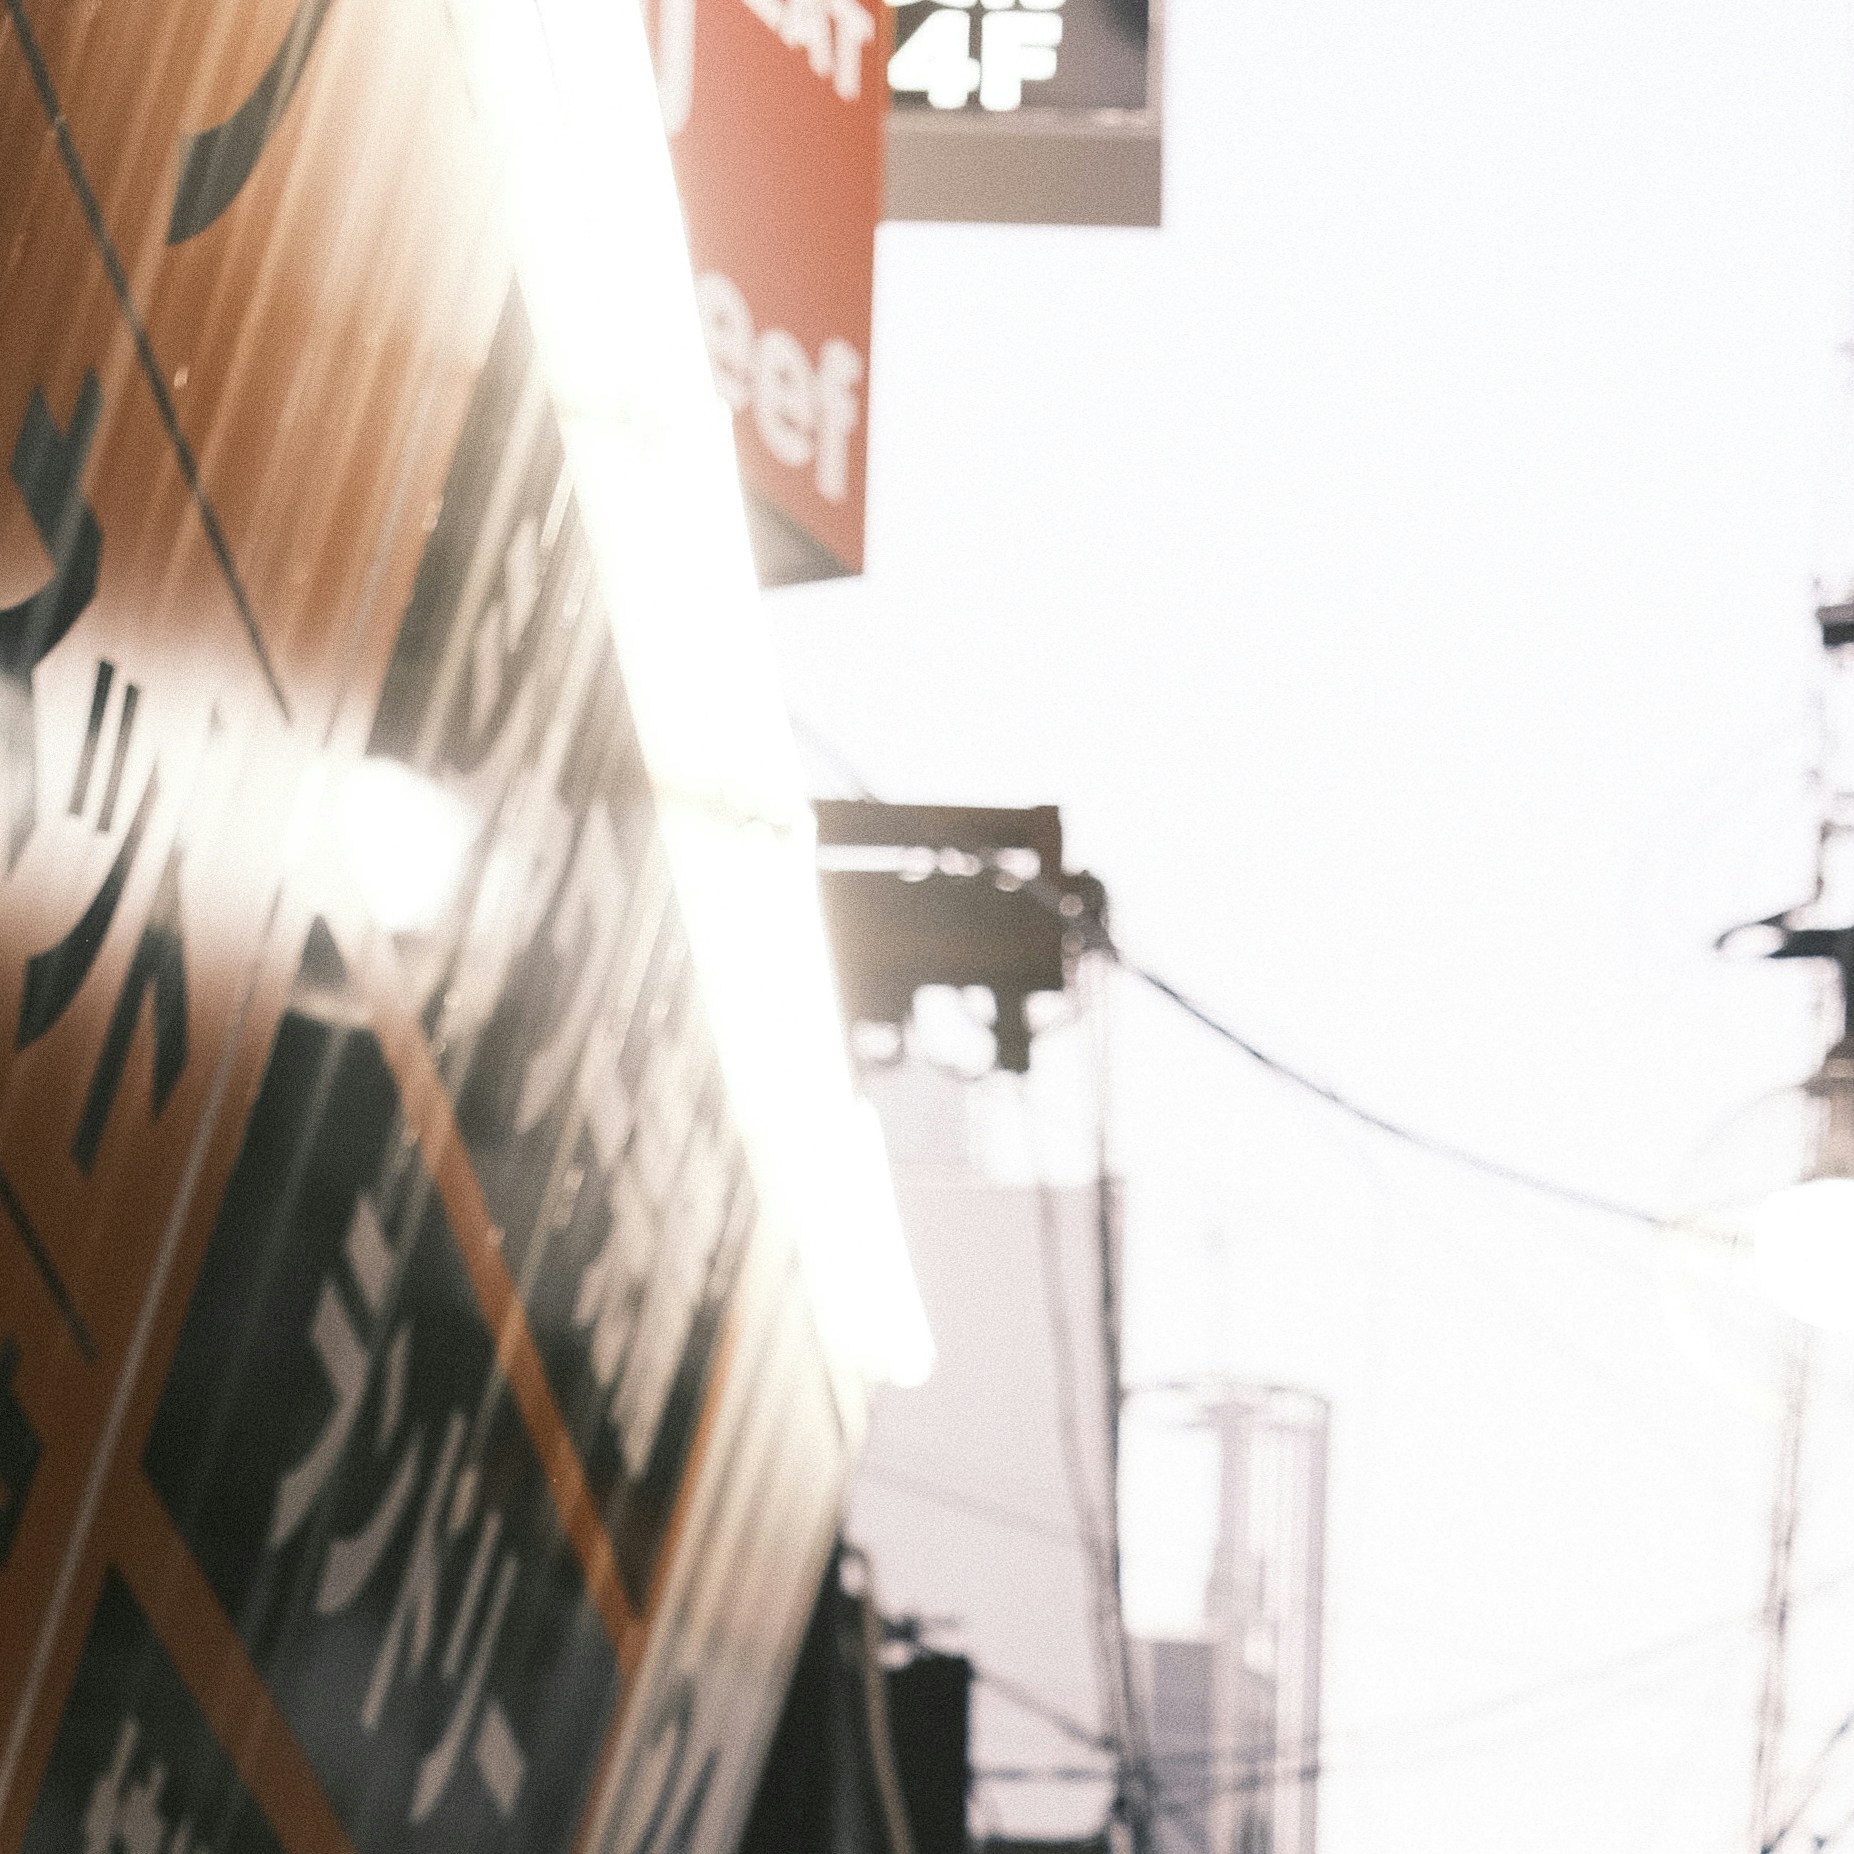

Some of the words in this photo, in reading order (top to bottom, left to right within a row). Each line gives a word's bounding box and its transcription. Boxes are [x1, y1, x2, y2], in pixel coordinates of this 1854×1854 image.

[886, 8, 1063, 113] 4F
[268, 1192, 527, 1824] ランドリー
